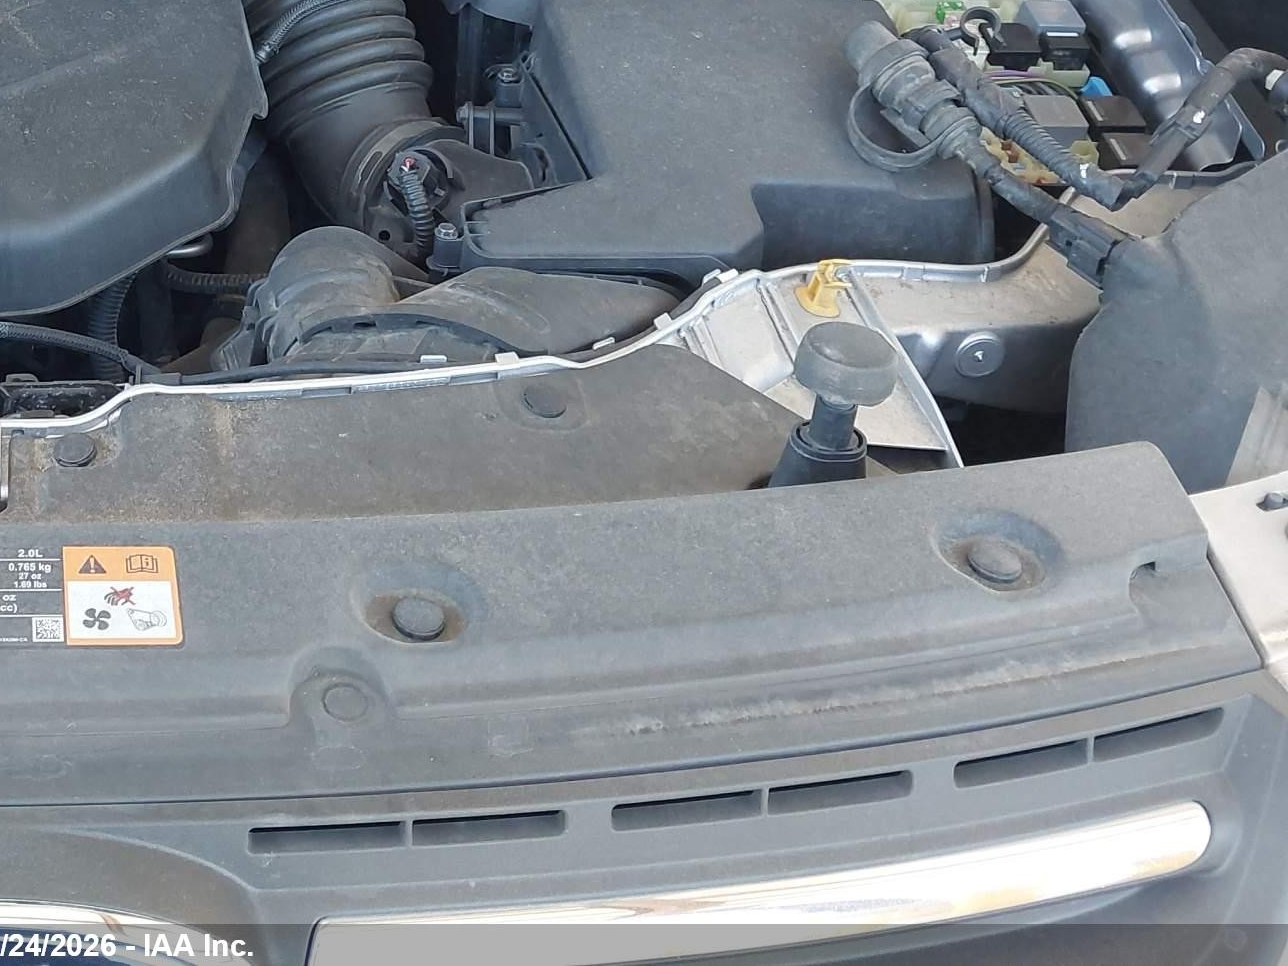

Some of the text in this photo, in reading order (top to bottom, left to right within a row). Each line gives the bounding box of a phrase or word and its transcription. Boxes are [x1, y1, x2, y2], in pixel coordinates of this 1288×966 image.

[18, 549, 43, 558] 2.0L
[8, 562, 52, 573] 0.765 kg
[0, 603, 18, 613] cc)
